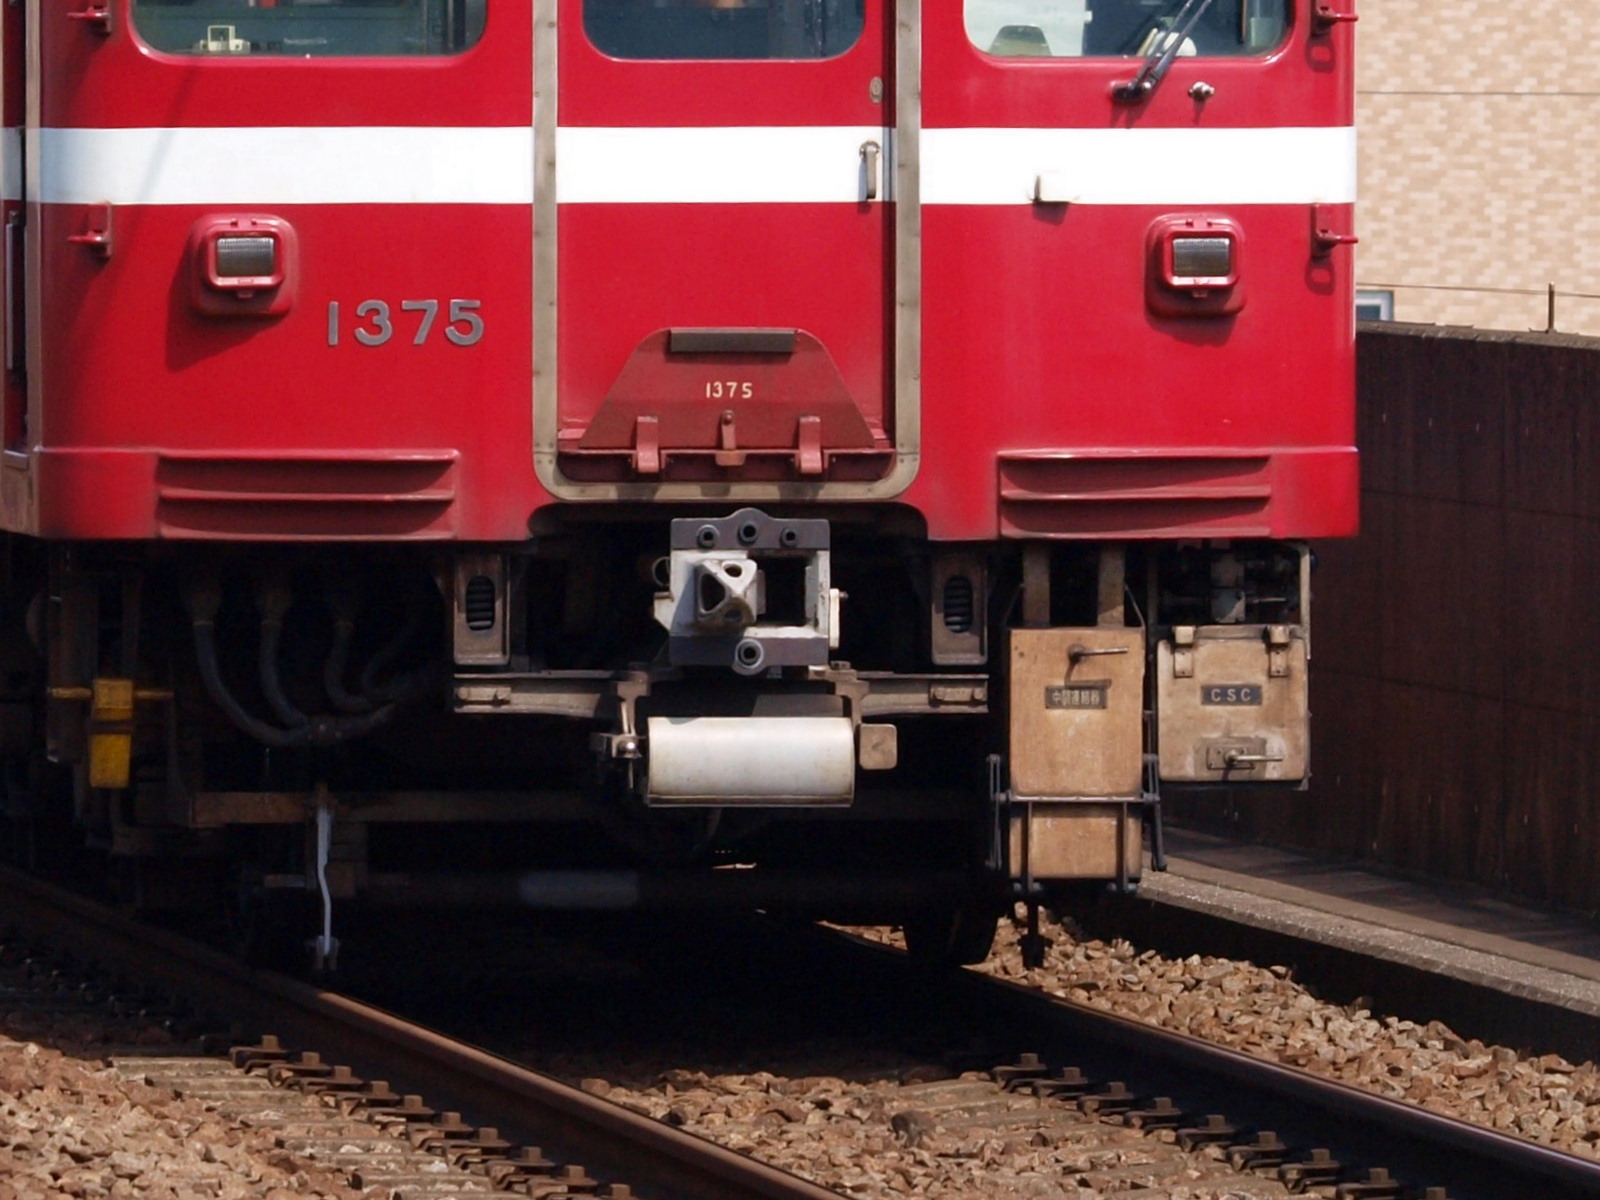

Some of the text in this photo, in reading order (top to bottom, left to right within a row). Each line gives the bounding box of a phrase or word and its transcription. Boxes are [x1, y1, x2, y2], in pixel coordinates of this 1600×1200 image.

[328, 299, 485, 346] 1375
[705, 381, 753, 399] 1375
[1211, 688, 1251, 702] CSC
